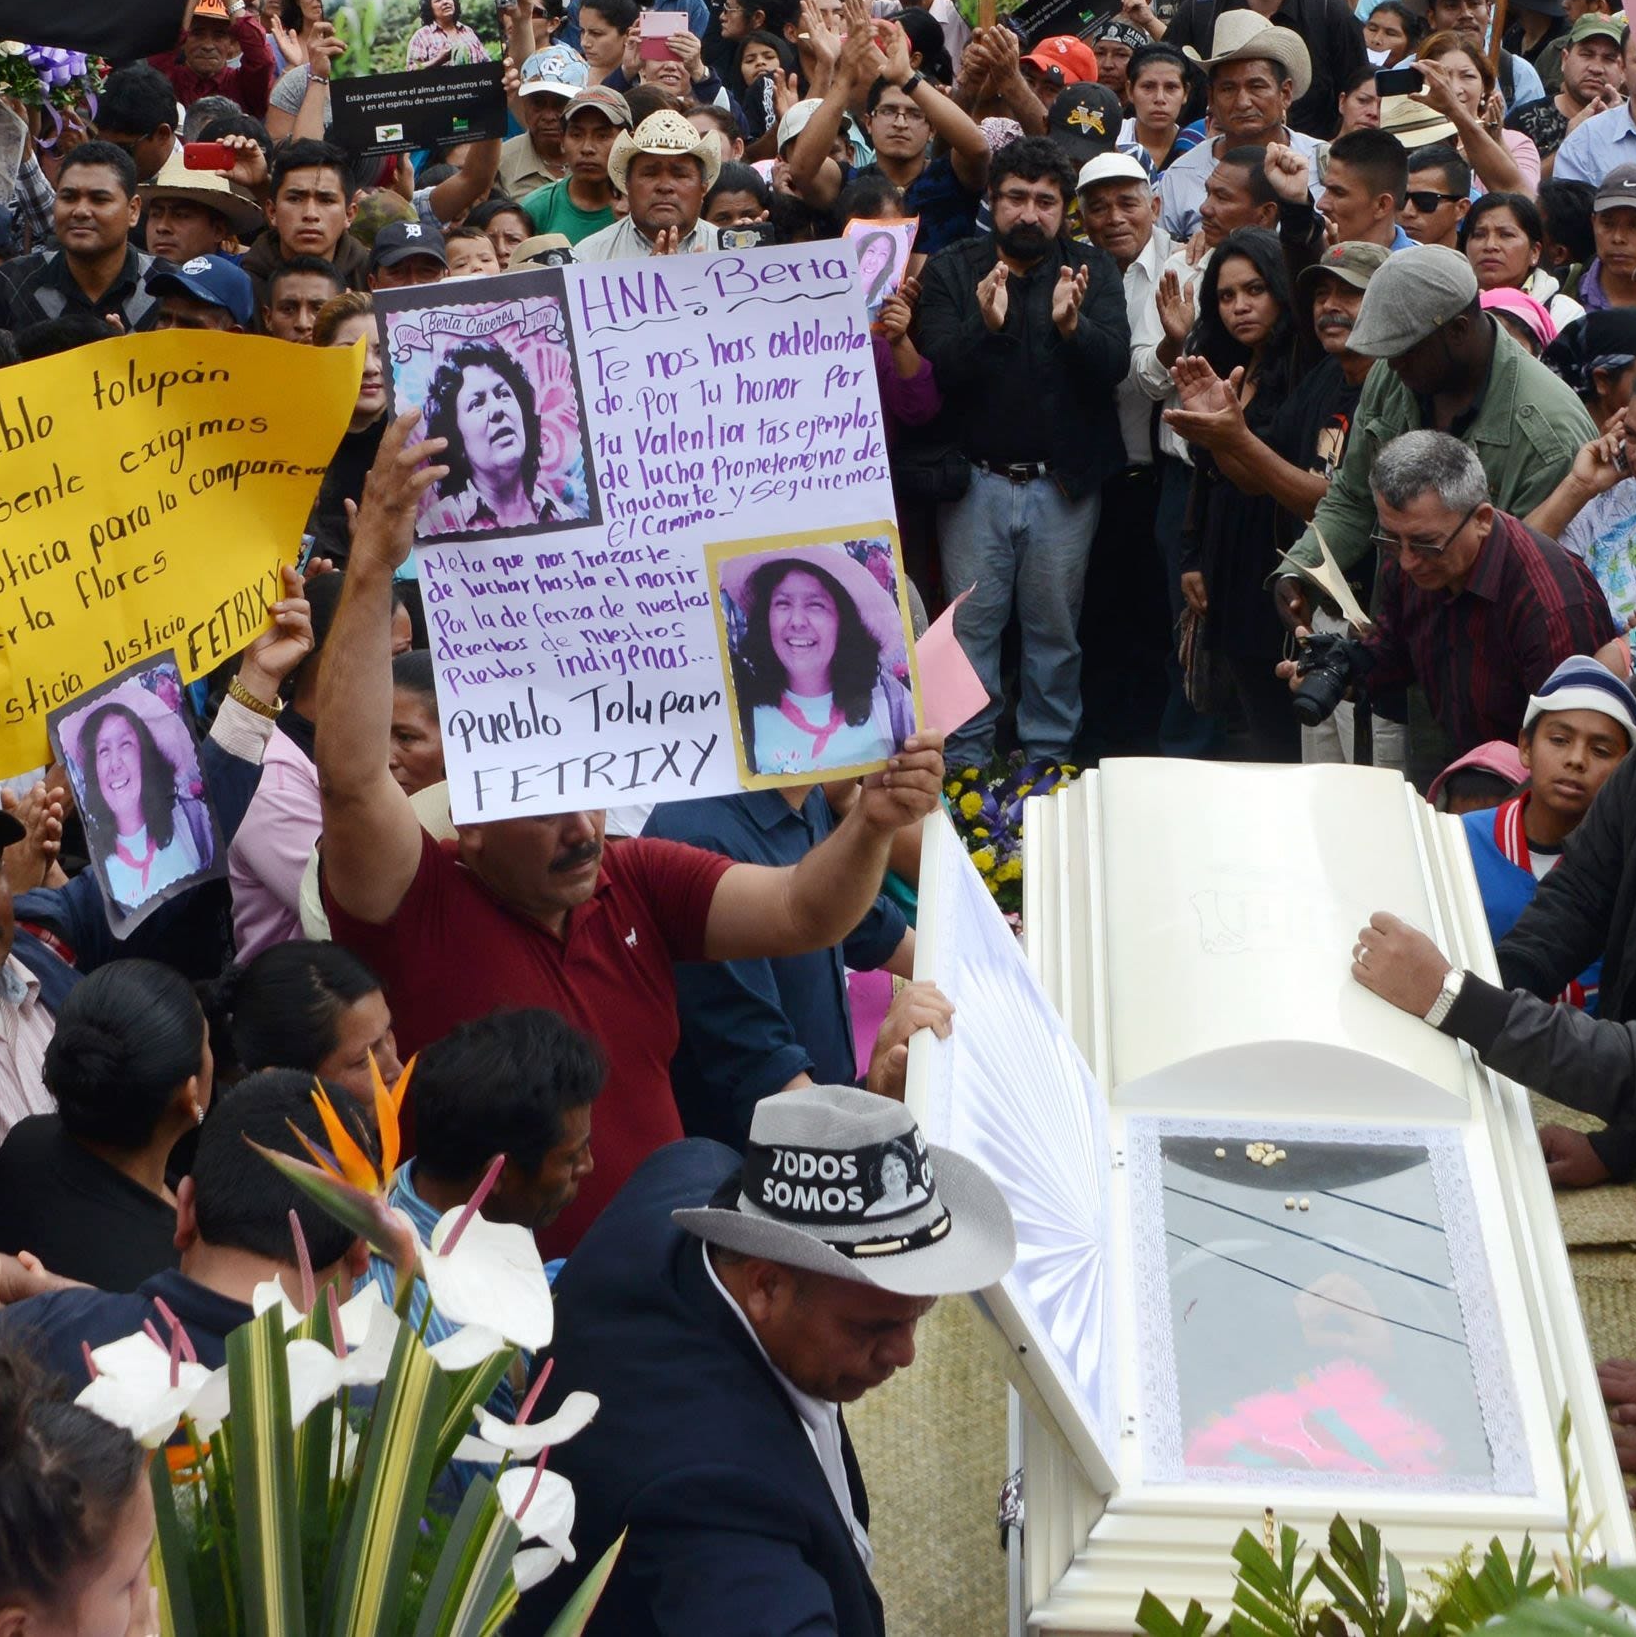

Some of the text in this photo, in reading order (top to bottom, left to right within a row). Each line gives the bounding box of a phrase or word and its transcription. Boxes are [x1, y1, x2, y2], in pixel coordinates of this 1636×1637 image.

[345, 78, 493, 103] Estás presente en el alma de nuestros ríos
[361, 104, 365, 112] y
[367, 101, 376, 110] en
[377, 99, 385, 109] el
[386, 97, 412, 110] espíritu
[414, 96, 424, 105] de
[425, 93, 455, 104] nuestras
[429, 311, 515, 333] Berta Cáceres
[587, 333, 756, 385] Te nos has
[737, 373, 803, 404] honor
[119, 416, 269, 474] exigimos
[89, 505, 151, 564] para
[160, 490, 178, 516] la
[75, 550, 168, 610] flores
[424, 549, 566, 579] Meta que nos
[427, 566, 700, 603] de luchar hasta el morir
[187, 558, 283, 673] FETRIXY
[437, 622, 686, 662] derechos de nuestros
[449, 680, 721, 753] Pueblo Tolupan
[473, 733, 718, 811] FETRIXY
[772, 1148, 858, 1180] TODOS
[763, 1177, 864, 1212] SOMOS
